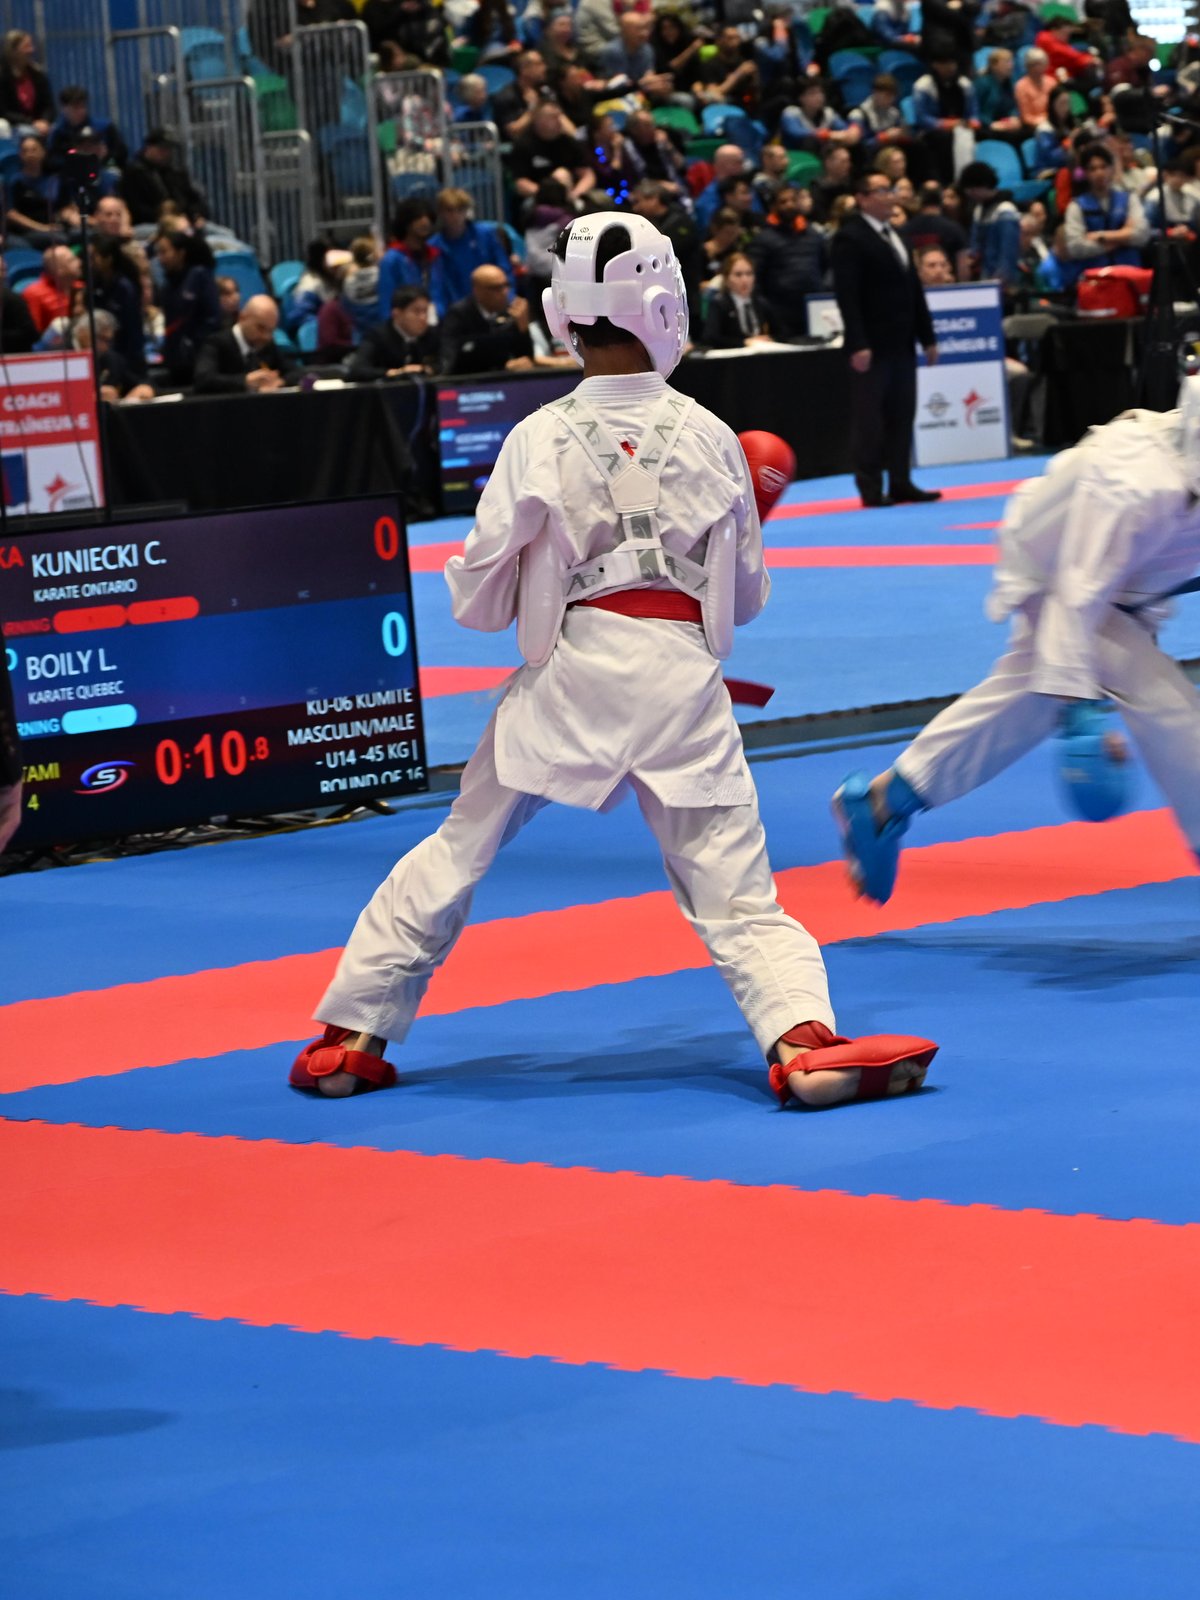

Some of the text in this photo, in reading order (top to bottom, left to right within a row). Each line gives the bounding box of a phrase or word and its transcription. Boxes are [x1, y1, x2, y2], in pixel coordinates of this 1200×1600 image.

[3, 391, 61, 412] COACH
[32, 543, 139, 578] KUNIECKI
[144, 541, 167, 565] C.
[374, 516, 399, 561] 0
[33, 578, 138, 602] KARATE ONTARIO
[26, 649, 92, 680] BOILY
[98, 648, 118, 672] L.
[382, 612, 407, 656] 0
[28, 680, 124, 705] KARATE QUEBEC
[355, 687, 413, 710] KUMITE
[287, 713, 416, 746] MASCULIN/MALE
[326, 749, 357, 768] U14
[360, 744, 385, 762] -45
[387, 741, 409, 759] KG
[27, 793, 40, 811] 4
